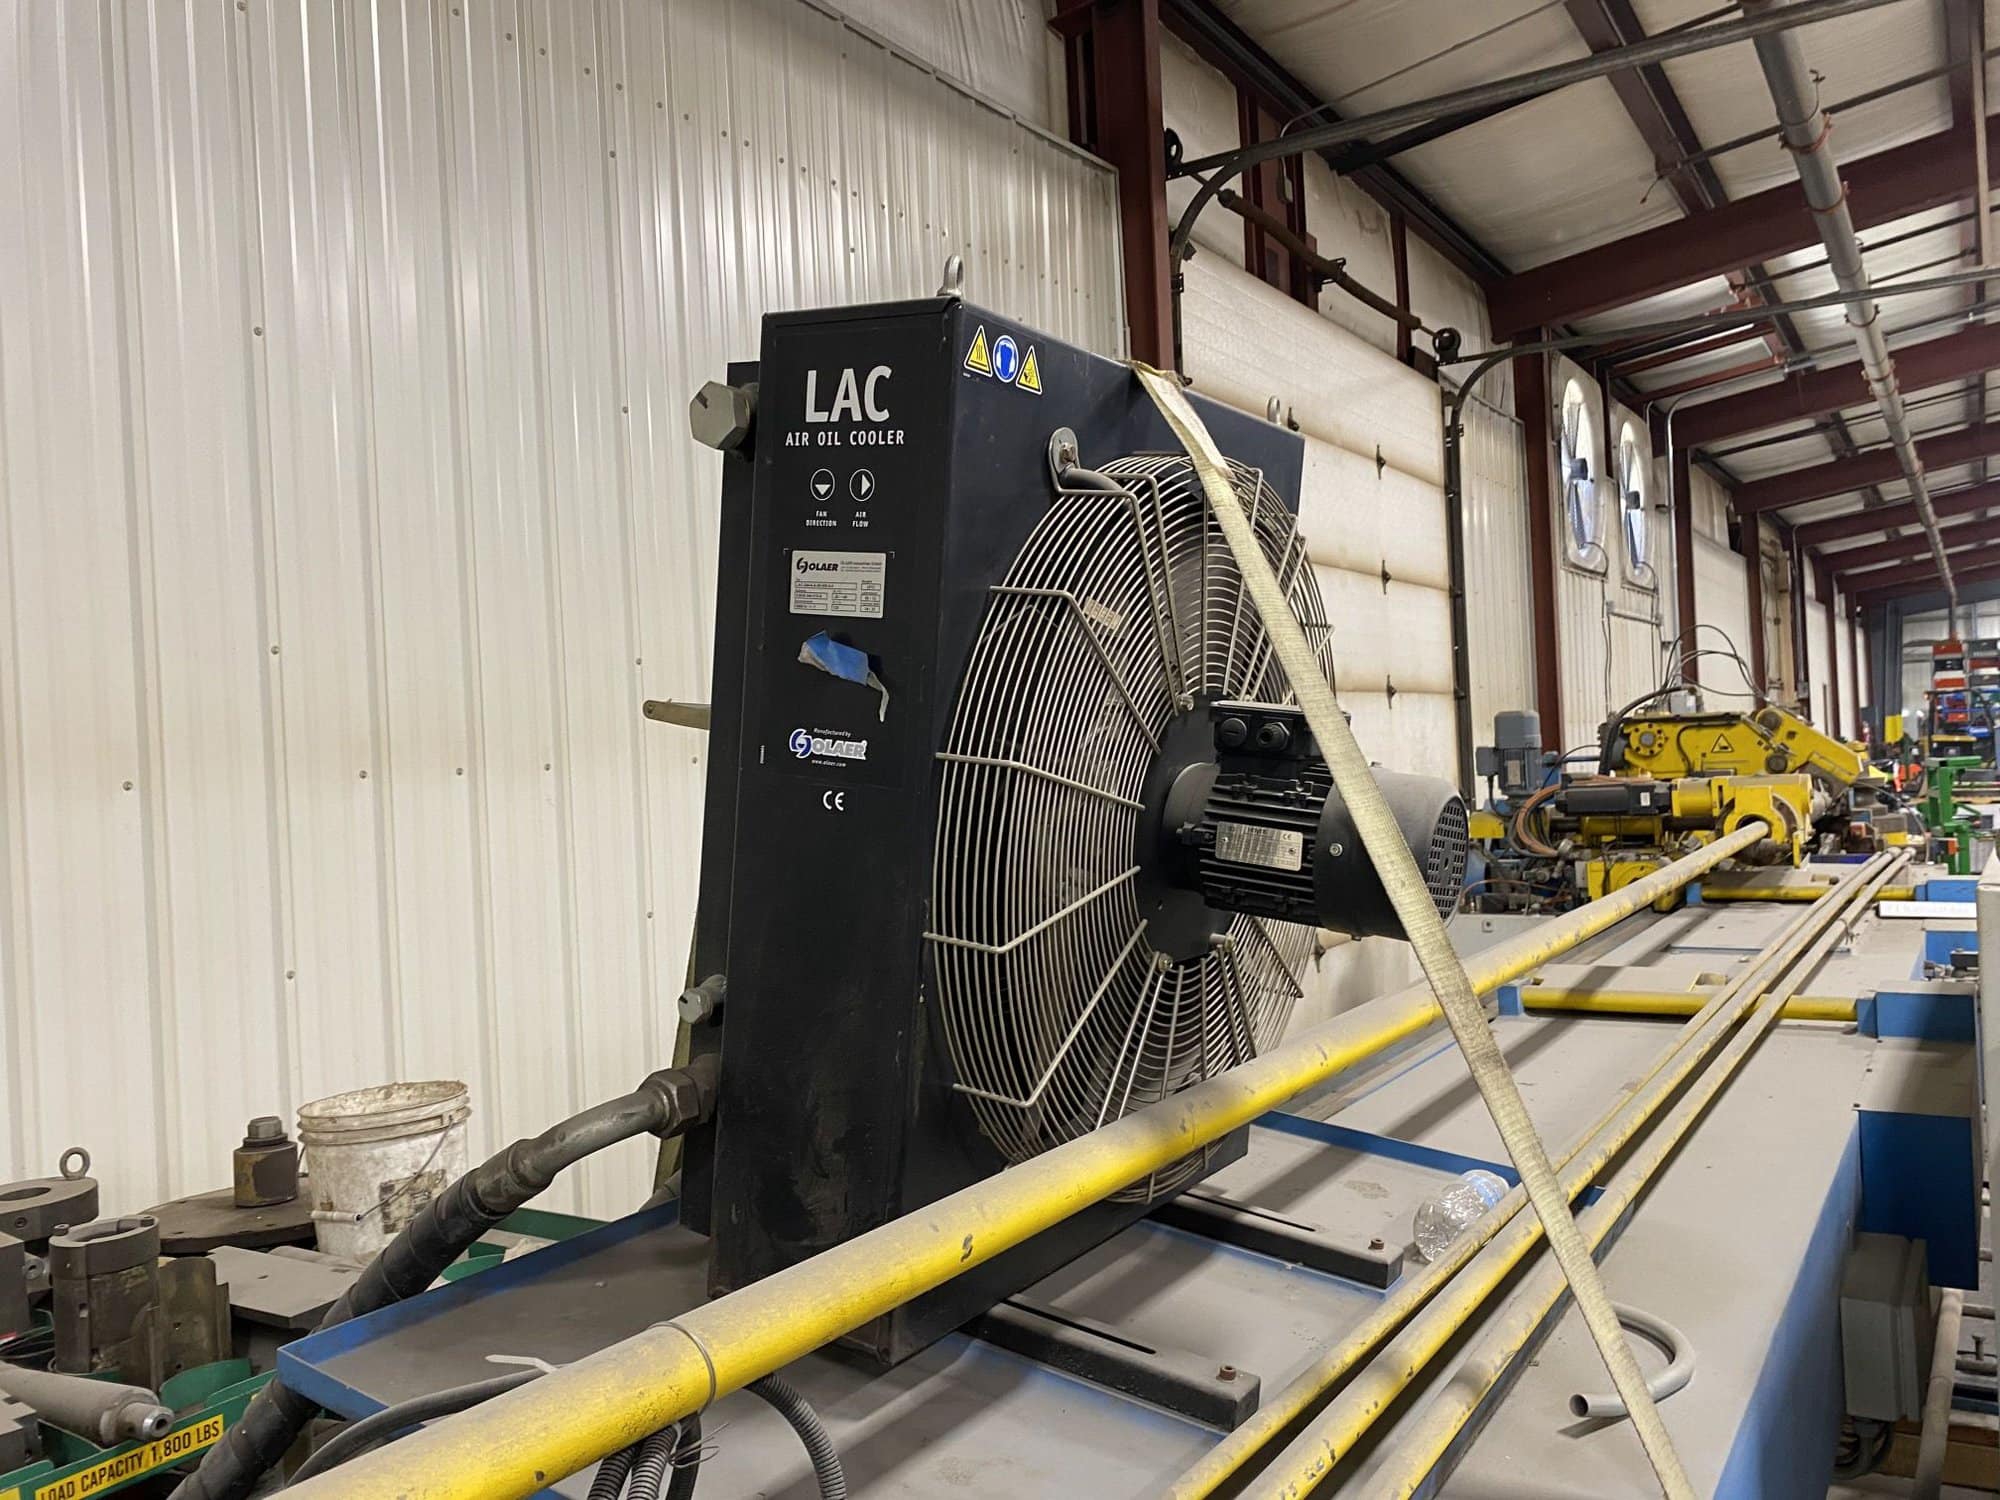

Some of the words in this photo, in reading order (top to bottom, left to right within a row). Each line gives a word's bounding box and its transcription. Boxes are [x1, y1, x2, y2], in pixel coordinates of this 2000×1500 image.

[805, 365, 892, 423] LAC
[785, 431, 809, 447] AIR
[817, 430, 841, 446] OIL
[850, 429, 904, 446] COOLER
[805, 519, 837, 527] DIRECTION
[852, 520, 869, 528] FLOW
[823, 790, 845, 811] CE
[81, 1452, 145, 1492] CAPACITY
[150, 1432, 191, 1463] 1,800
[197, 1420, 220, 1444] LBS
